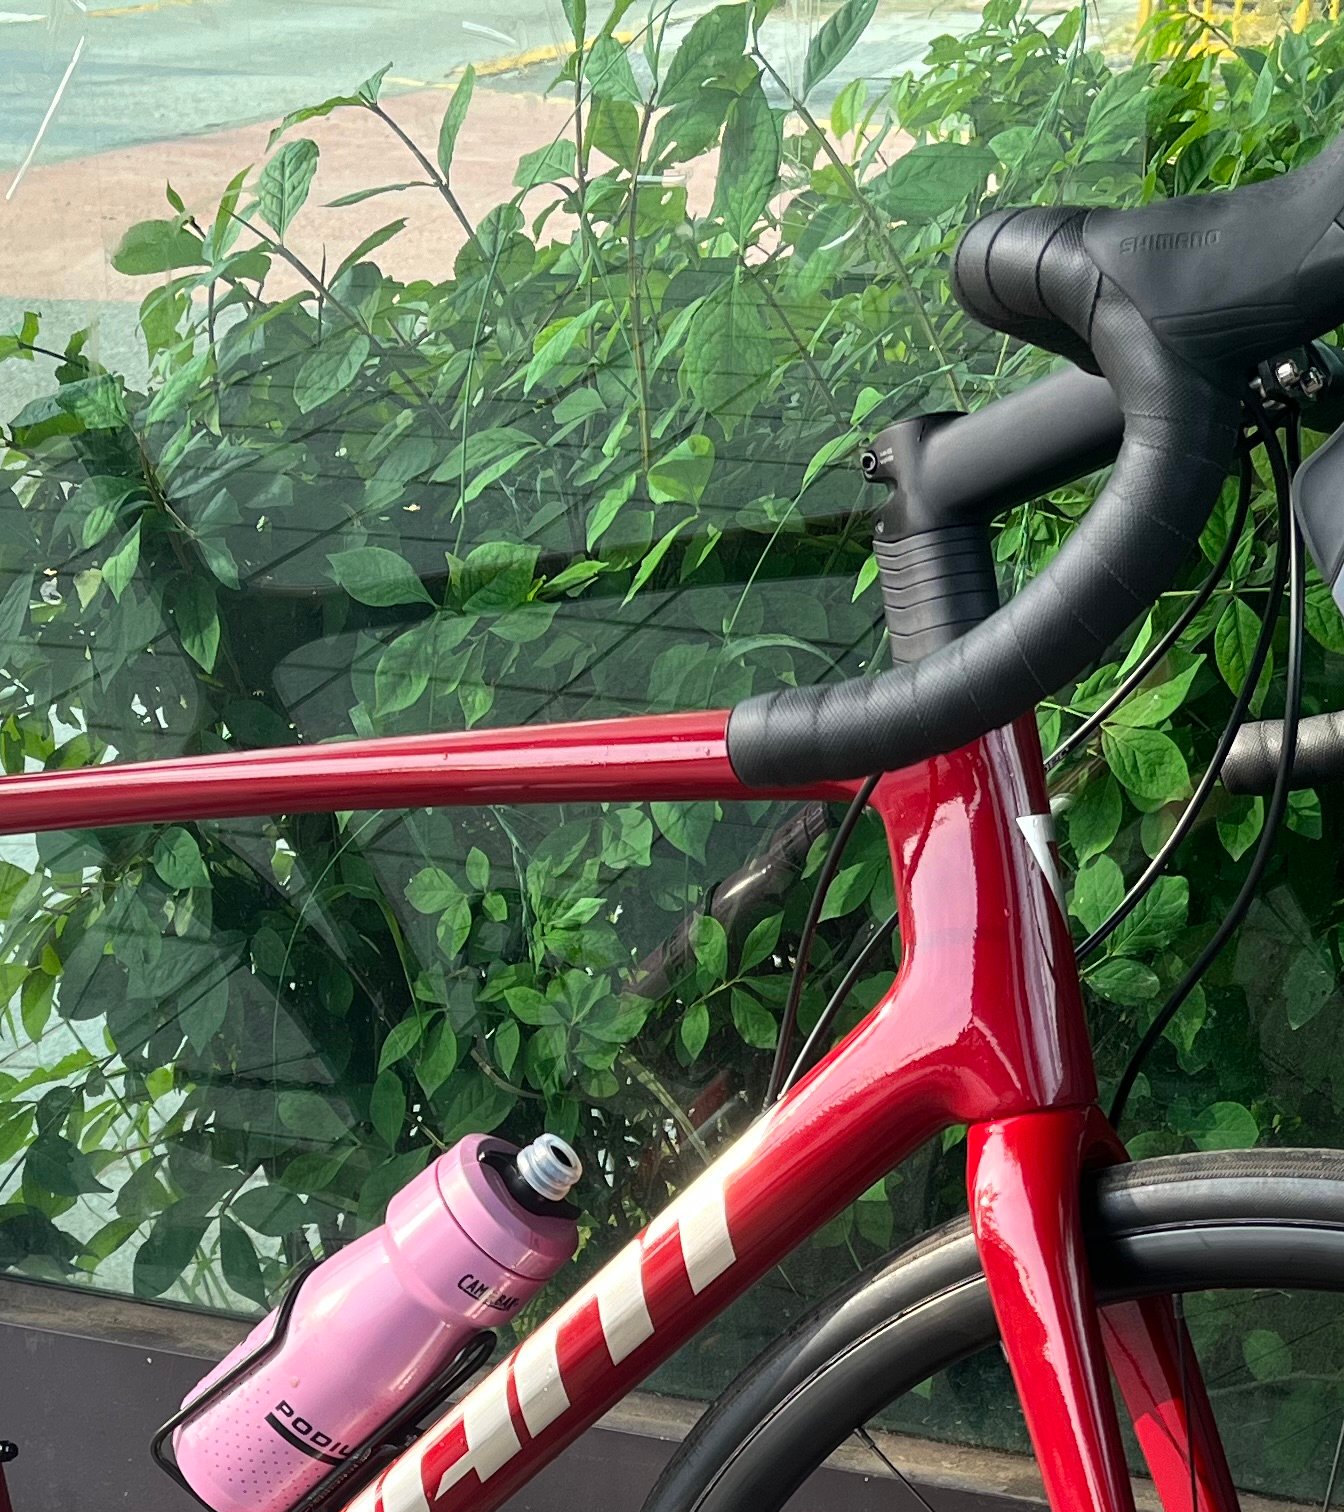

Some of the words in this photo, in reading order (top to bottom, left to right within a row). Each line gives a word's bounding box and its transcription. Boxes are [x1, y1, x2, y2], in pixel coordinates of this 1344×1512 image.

[1119, 228, 1222, 255] SHIMANO
[457, 1273, 520, 1312] CAMBAK
[274, 1399, 355, 1458] PODIU
